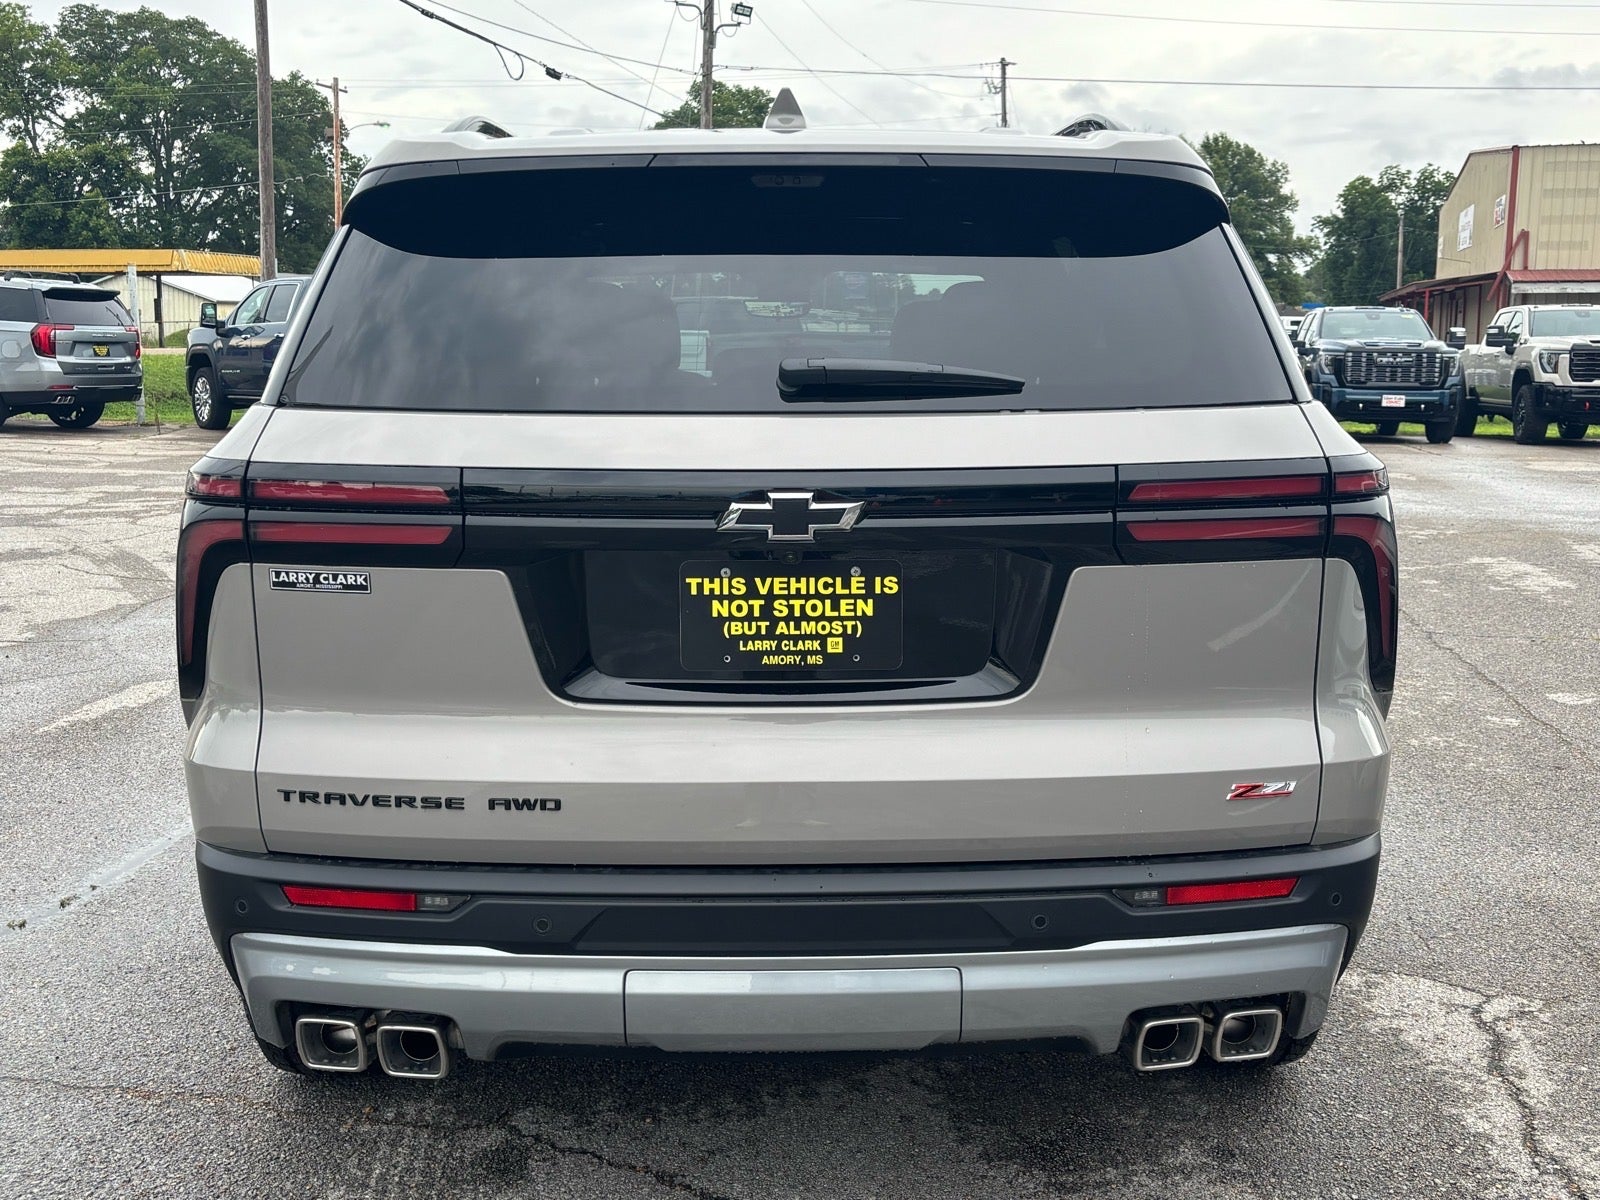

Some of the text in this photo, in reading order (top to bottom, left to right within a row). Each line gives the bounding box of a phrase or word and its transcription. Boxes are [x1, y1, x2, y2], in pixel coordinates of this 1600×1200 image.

[272, 571, 367, 585] LARRY CLARK
[685, 576, 899, 596] THIS VEHICLE IS
[711, 598, 874, 618] NOT STOLEN
[723, 620, 863, 638] (BUT ALMOST)
[739, 639, 821, 651] LARRY CLARK
[761, 655, 823, 666] AMORY, MS
[277, 788, 562, 811] TRAVERSE AWD
